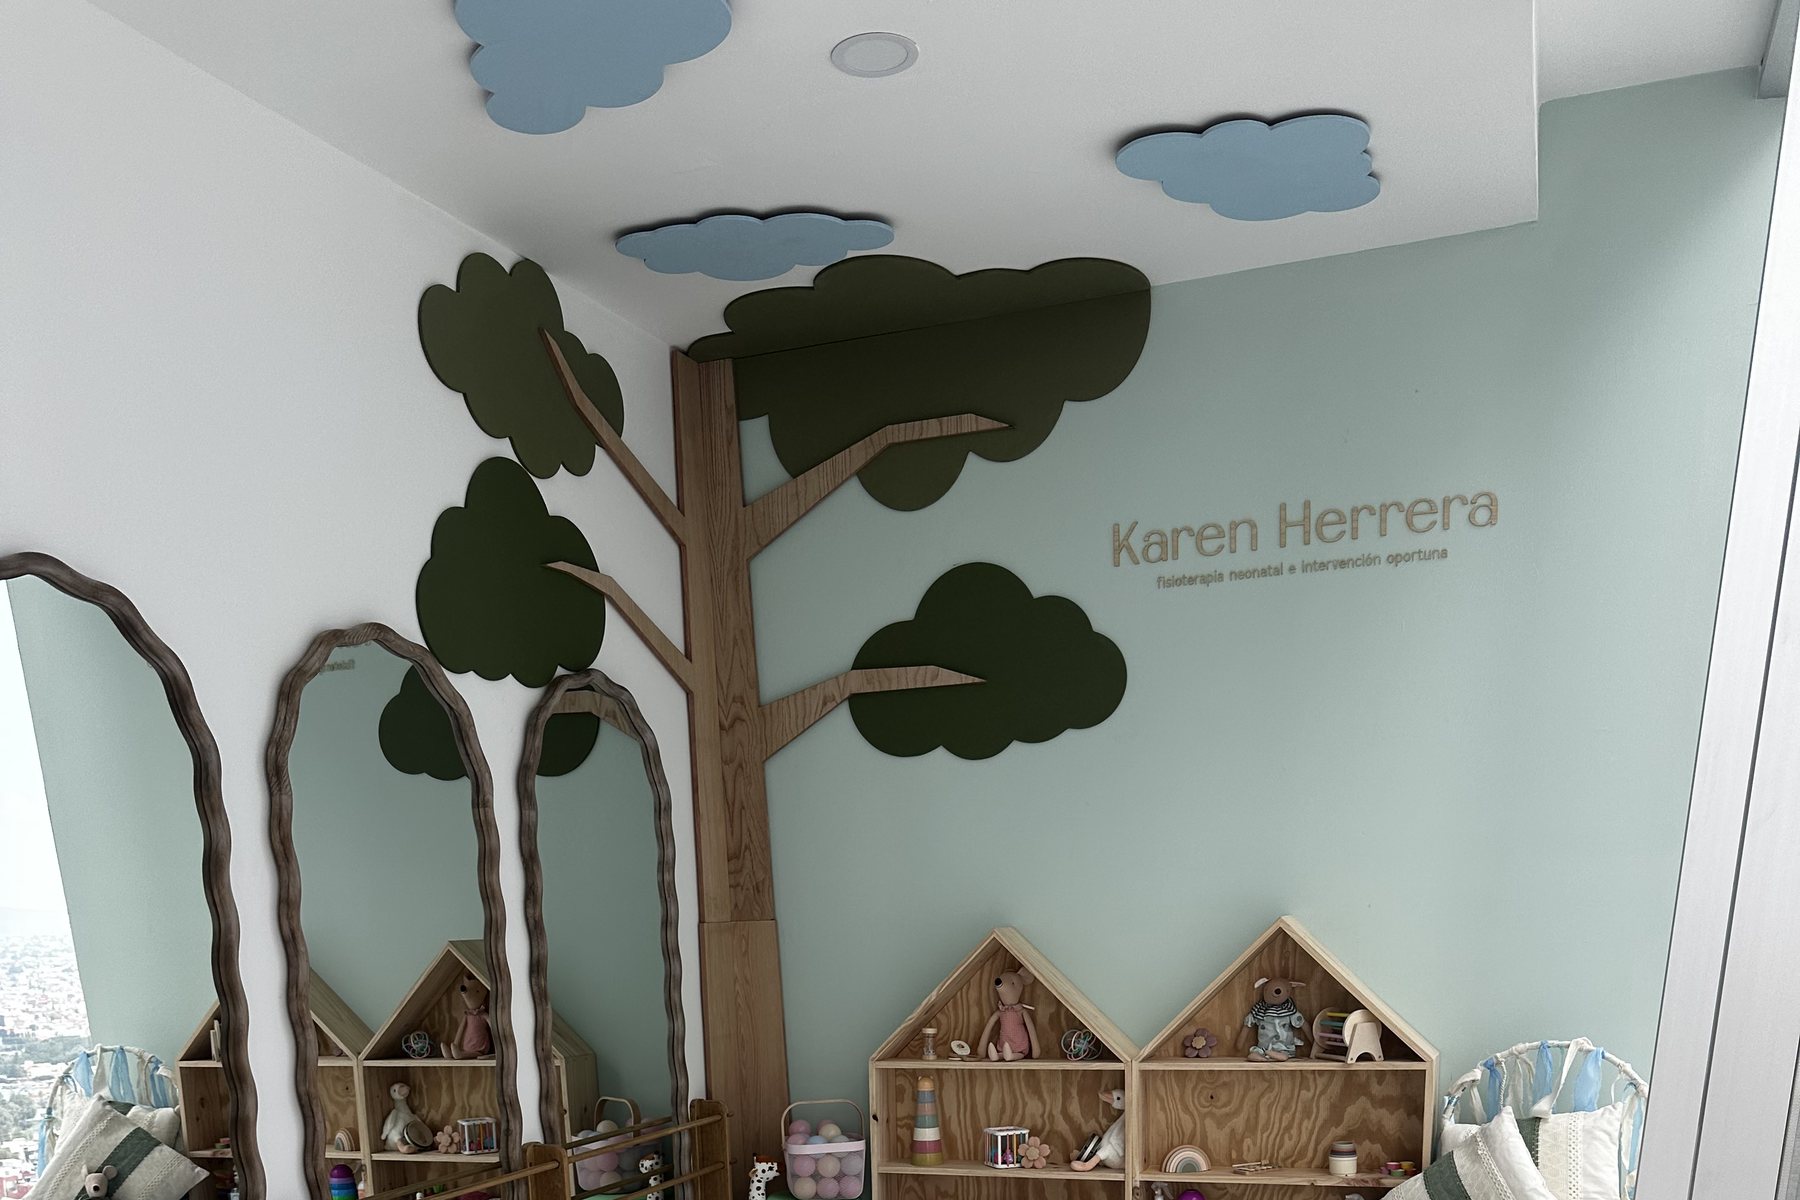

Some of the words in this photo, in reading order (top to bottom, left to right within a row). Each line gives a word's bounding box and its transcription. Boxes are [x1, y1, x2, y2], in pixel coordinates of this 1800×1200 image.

[1112, 519, 1258, 567] Karen
[1279, 491, 1499, 548] Herrera
[1156, 569, 1225, 589] fisioterapia
[1229, 562, 1284, 581] neonatal
[1287, 565, 1297, 575] e
[1301, 552, 1382, 574] intervención
[1386, 547, 1449, 567] oportuna
